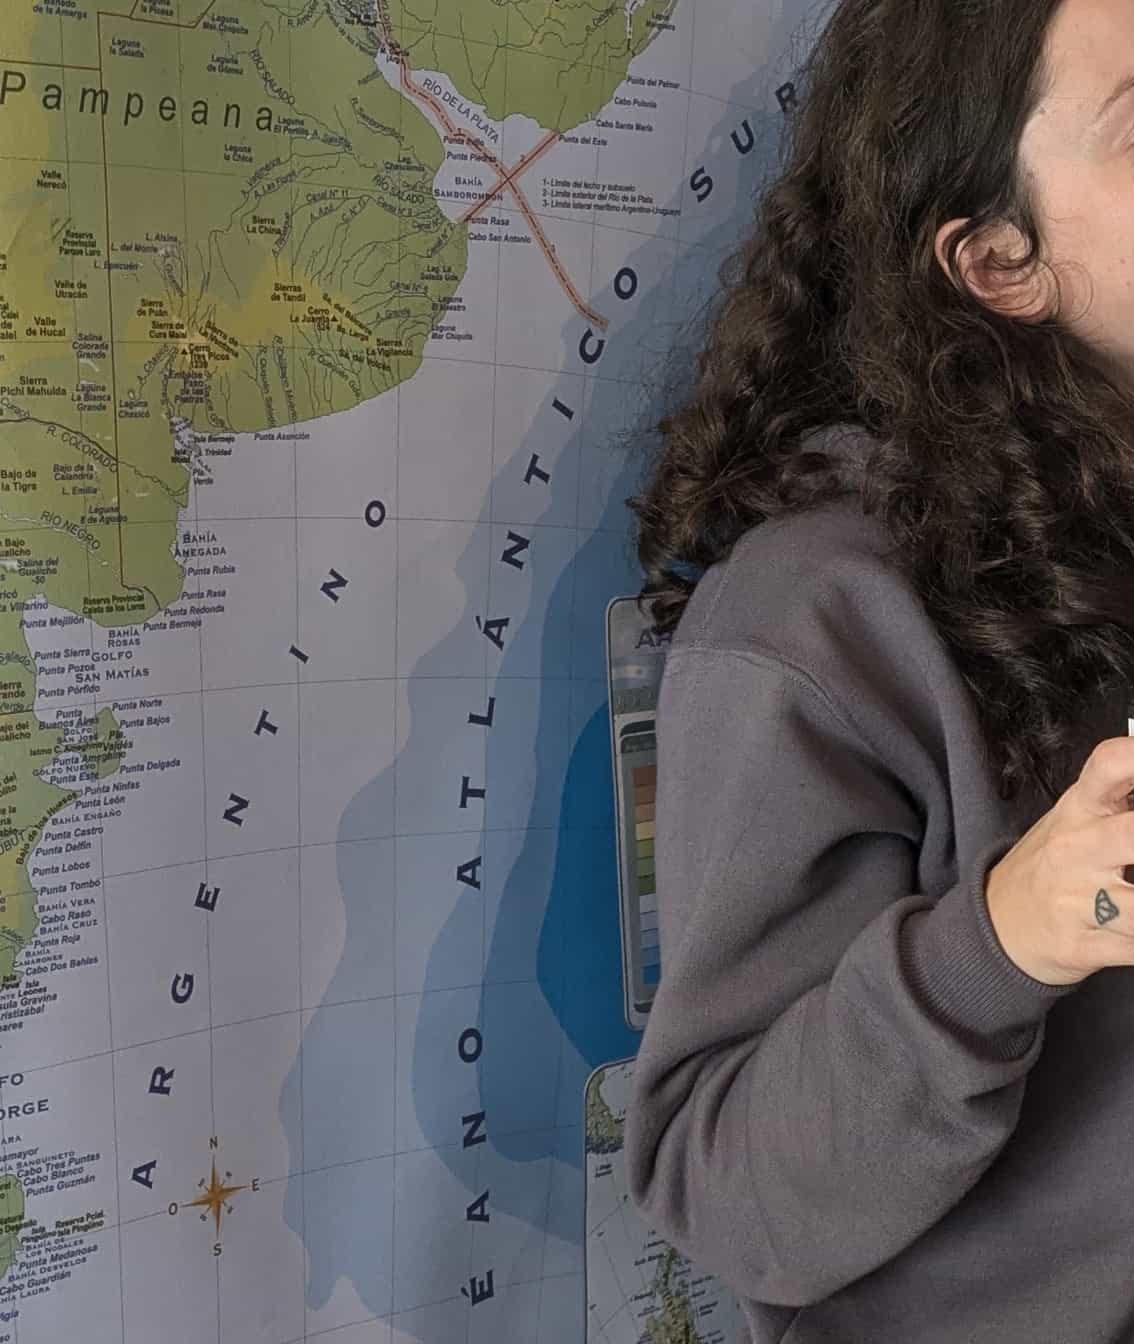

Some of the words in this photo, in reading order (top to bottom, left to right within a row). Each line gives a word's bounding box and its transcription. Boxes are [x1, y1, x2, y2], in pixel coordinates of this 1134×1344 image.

[0, 69, 273, 132] Pampeana
[422, 77, 443, 97] RÍO
[440, 90, 459, 107] DE
[469, 113, 500, 144] PLATA
[689, 81, 801, 204] SUR
[183, 531, 217, 544] BAHÍA
[91, 650, 133, 662] GOLFO
[75, 673, 101, 683] SAN
[106, 666, 150, 680] MATÍAS
[131, 500, 386, 1189] ARGENTINO
[32, 865, 59, 877] Punta
[62, 860, 90, 873] Lobos
[39, 884, 67, 896] Punta
[70, 878, 101, 892] Tombo
